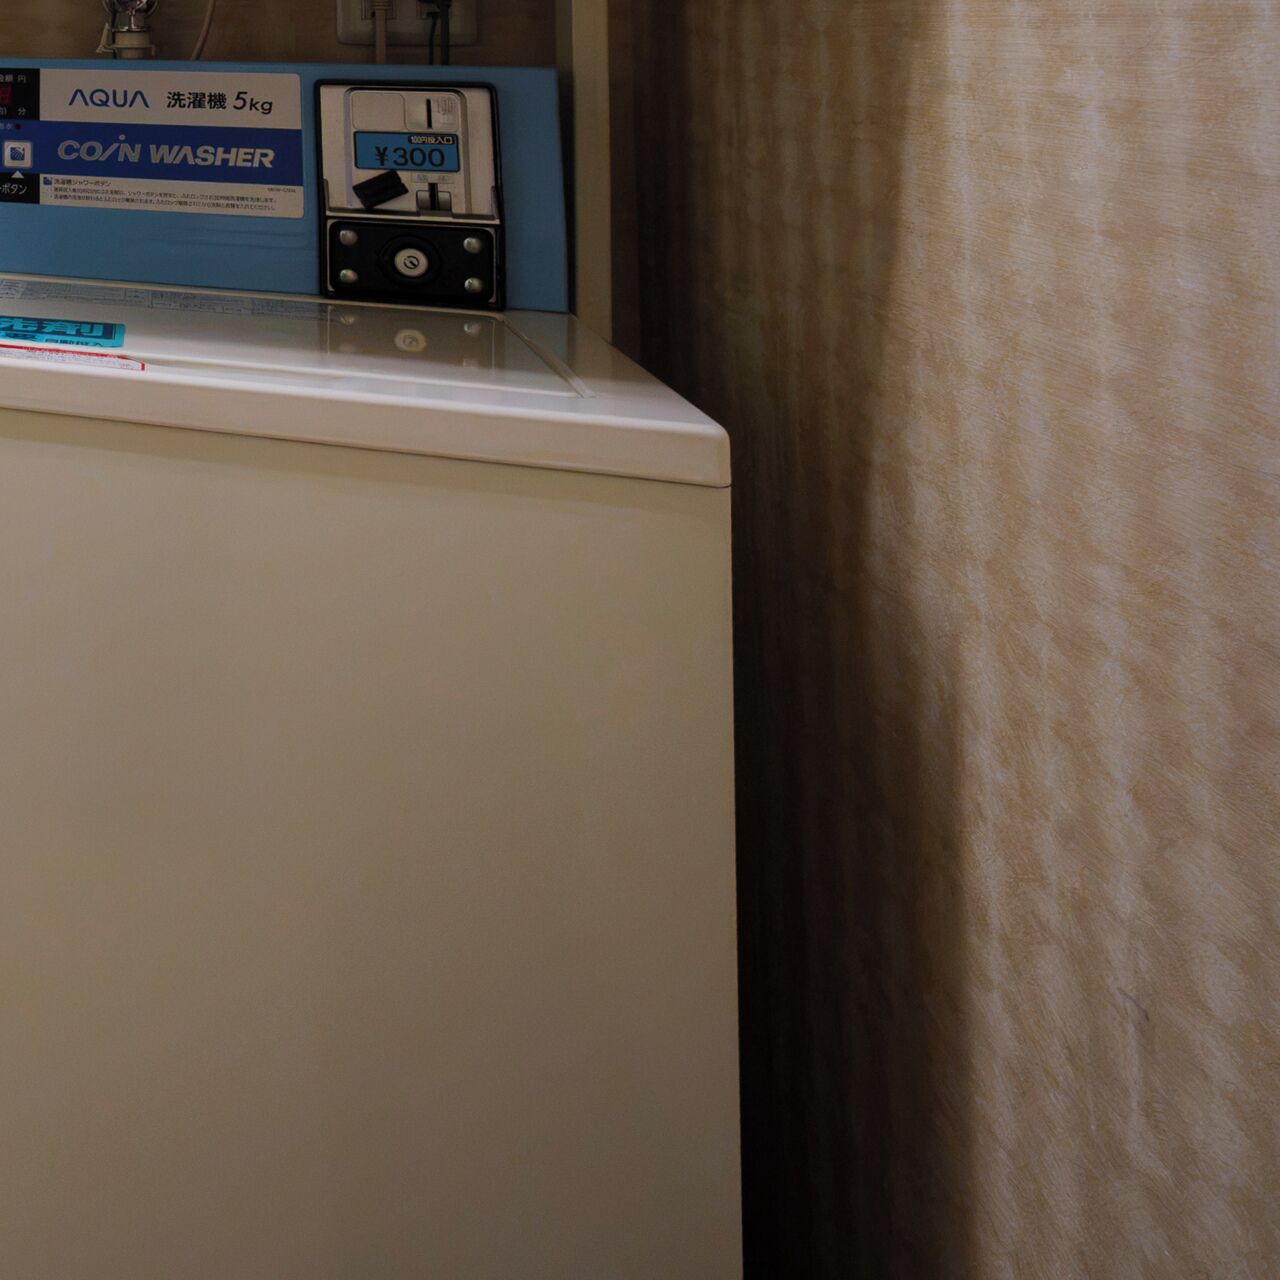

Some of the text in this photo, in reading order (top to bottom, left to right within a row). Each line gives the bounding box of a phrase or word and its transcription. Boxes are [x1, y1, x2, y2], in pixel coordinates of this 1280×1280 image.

[68, 88, 273, 115] AQUA 洗濯機 5kg
[150, 144, 275, 168] WASHER
[375, 146, 445, 167] ¥300
